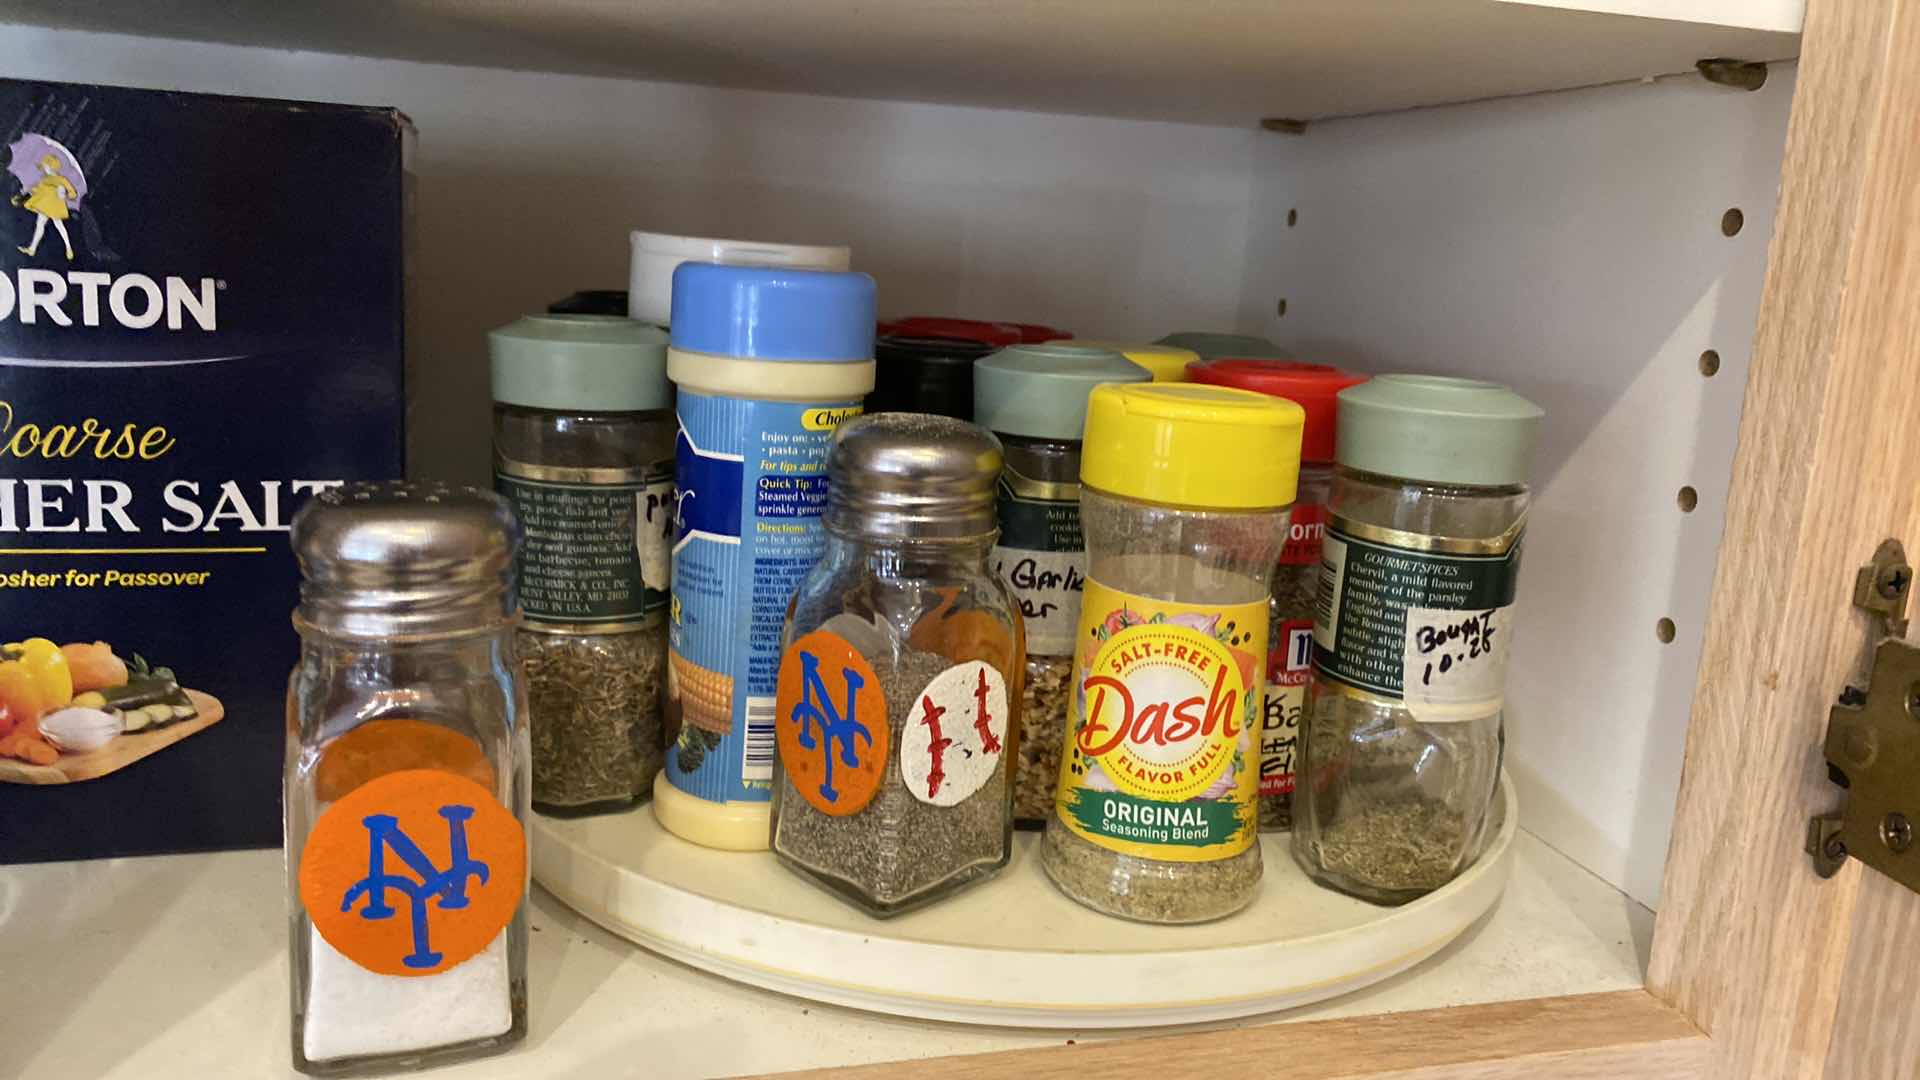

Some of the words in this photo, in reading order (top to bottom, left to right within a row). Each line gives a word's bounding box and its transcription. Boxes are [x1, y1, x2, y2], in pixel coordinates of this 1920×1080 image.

[0, 268, 217, 331] RTON
[761, 431, 788, 444] Enjoy
[769, 446, 798, 457] pasta
[760, 460, 777, 470] For
[780, 460, 797, 474] tips
[800, 461, 817, 472] and
[759, 478, 791, 490] Quick
[759, 490, 798, 501] Steamed
[758, 504, 795, 516] sprinkle
[65, 569, 100, 587] for
[104, 569, 211, 587] Passover
[1391, 574, 1398, 582] a
[1401, 573, 1427, 586] mild
[1431, 576, 1473, 591] flavored
[1349, 576, 1387, 594] member
[1391, 585, 1403, 596] of
[1407, 587, 1425, 599] the
[1428, 591, 1467, 607] parsley
[1344, 612, 1359, 626] the
[1346, 601, 1383, 621] England
[1384, 609, 1404, 623] and
[1111, 642, 1211, 674] SALT-FREE
[1367, 645, 1387, 658] and
[1389, 650, 1399, 660] is
[1340, 651, 1362, 665] with
[1365, 658, 1400, 674] other
[1338, 663, 1381, 683] enhance
[1076, 665, 1241, 757] Dash
[1118, 756, 1184, 784] FLAVOR
[1190, 742, 1222, 776] FULL
[1103, 799, 1209, 827] ORIGINAL
[1102, 818, 1169, 842] Seasoning
[1172, 826, 1209, 841] Blend
